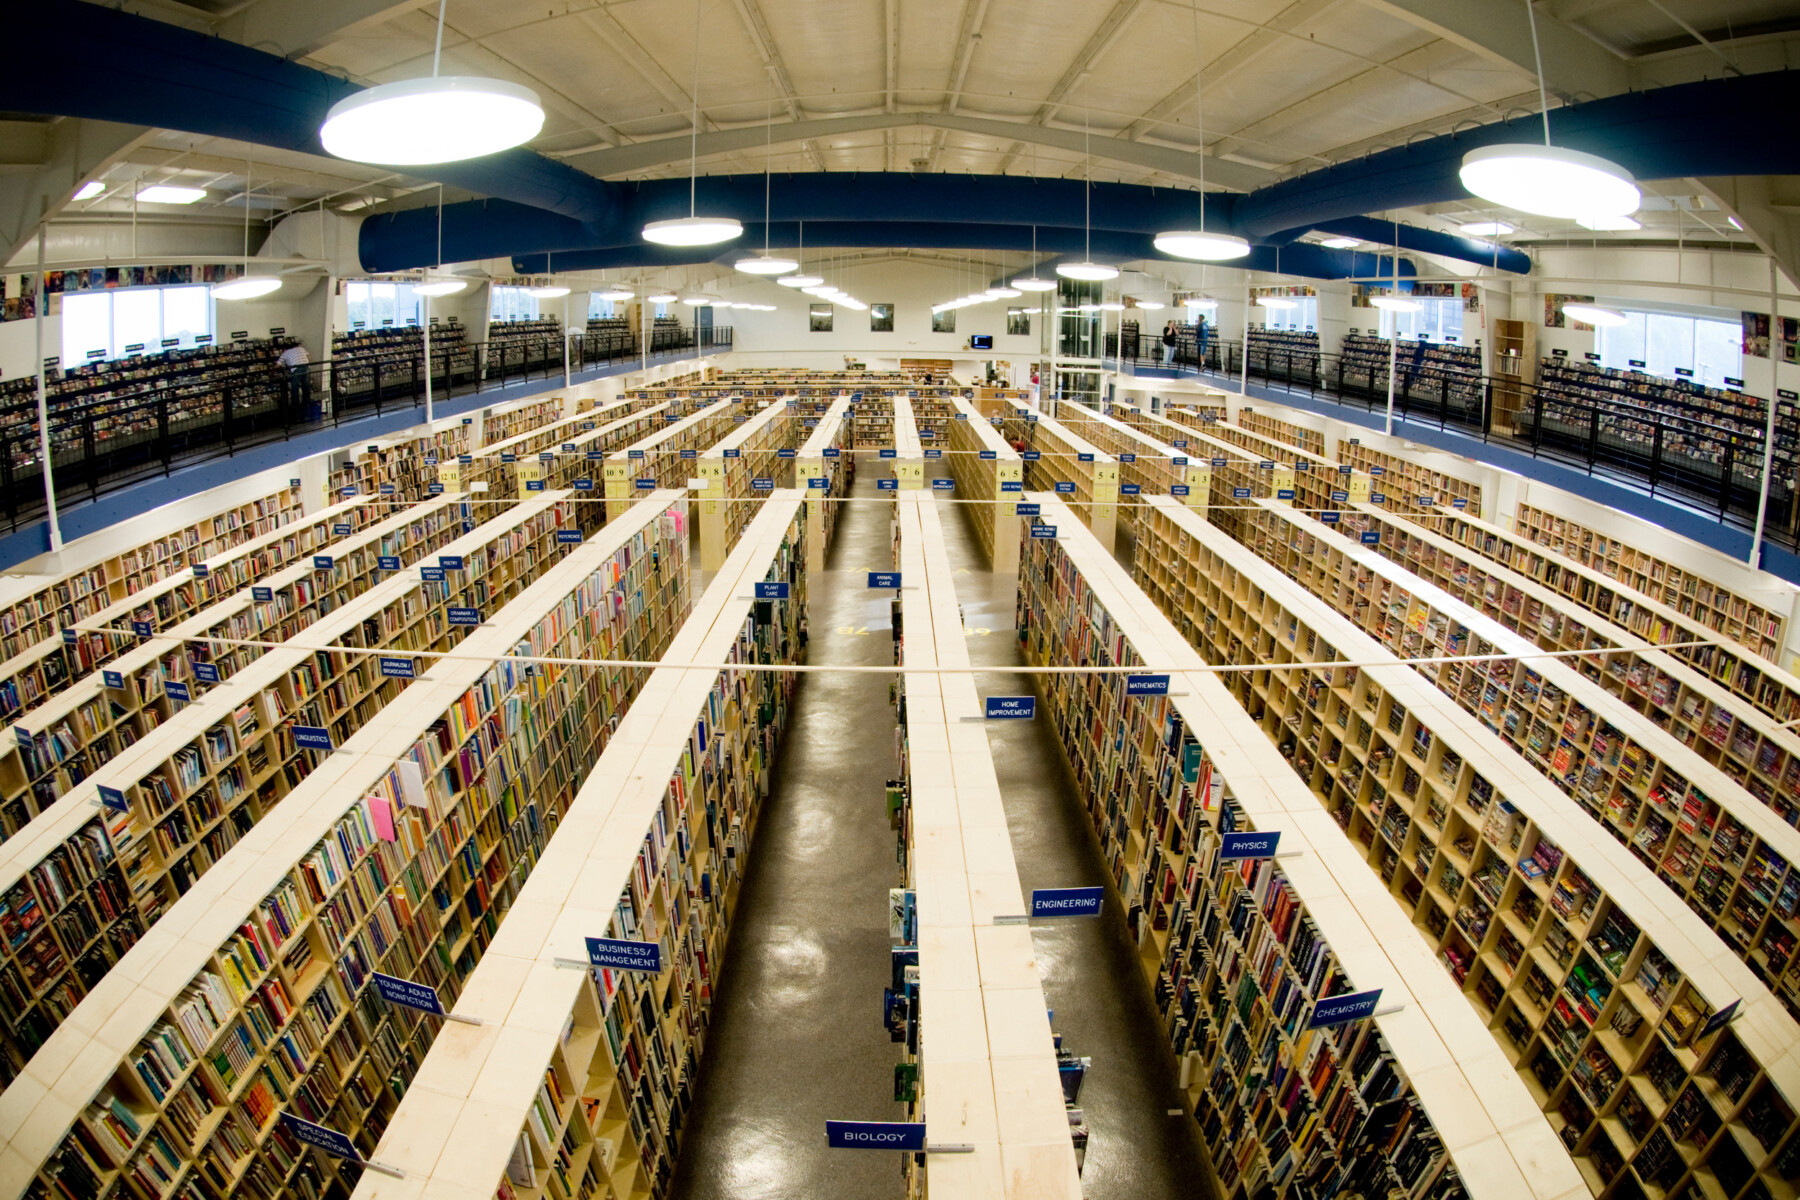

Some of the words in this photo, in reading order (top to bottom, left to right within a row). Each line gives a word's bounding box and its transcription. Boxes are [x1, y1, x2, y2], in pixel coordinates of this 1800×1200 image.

[383, 667, 413, 675] BROADCASTING
[296, 734, 329, 743] LINGUISTICS
[1231, 841, 1268, 851] PHYSICS
[1035, 898, 1097, 909] ENGINEERING
[598, 943, 651, 957] BUSINESS/
[592, 953, 656, 968] MANAGEMENT
[377, 978, 406, 993] YOUNG
[408, 988, 433, 1000] ADULT
[385, 989, 433, 1009] NONFICTION
[1316, 1000, 1374, 1019] CHEMISTRY
[296, 1122, 337, 1143] SPECIAL
[843, 1131, 907, 1142] BIOLOGY
[297, 1130, 350, 1155] EDUCATION
